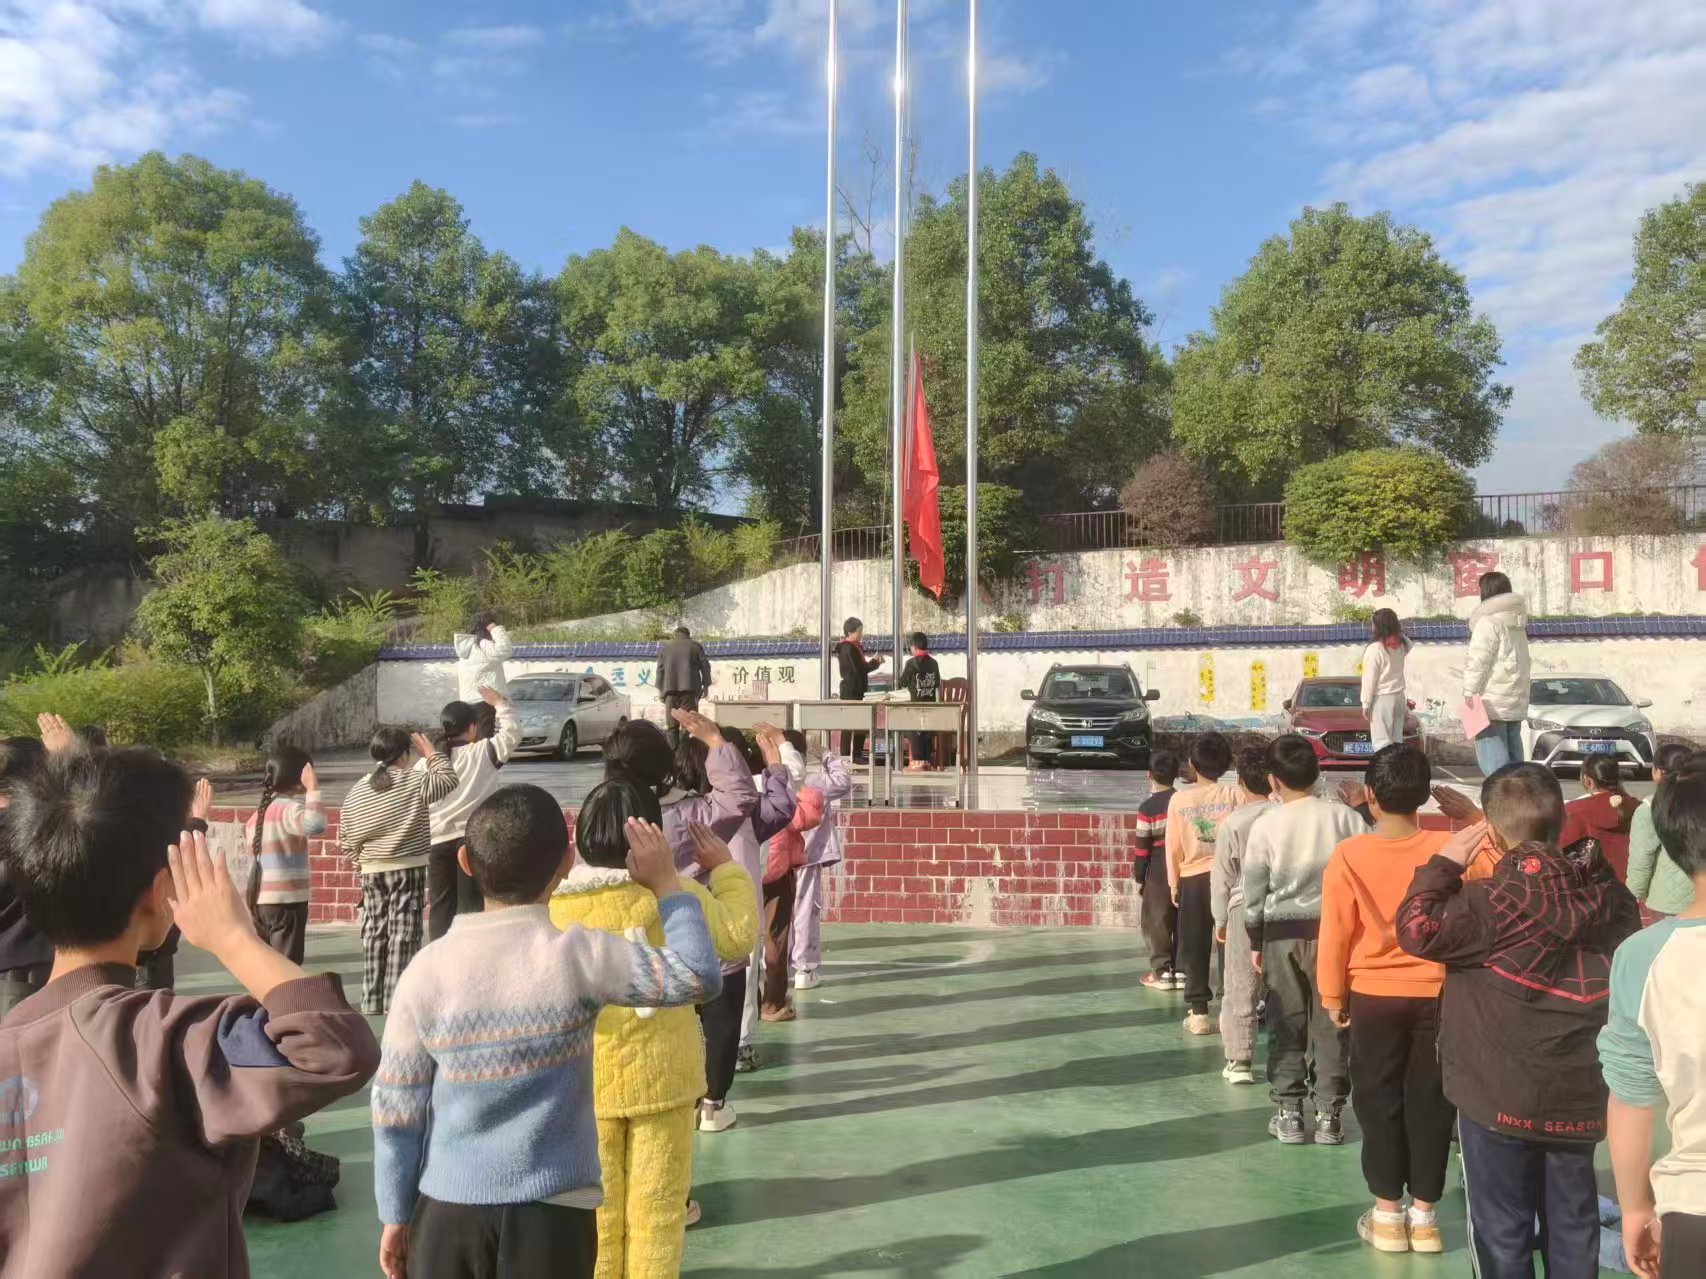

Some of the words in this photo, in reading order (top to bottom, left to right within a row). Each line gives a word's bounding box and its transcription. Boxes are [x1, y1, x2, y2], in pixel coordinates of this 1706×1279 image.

[1025, 543, 1706, 605] 打造文明窗口
[733, 666, 796, 684] 价值观
